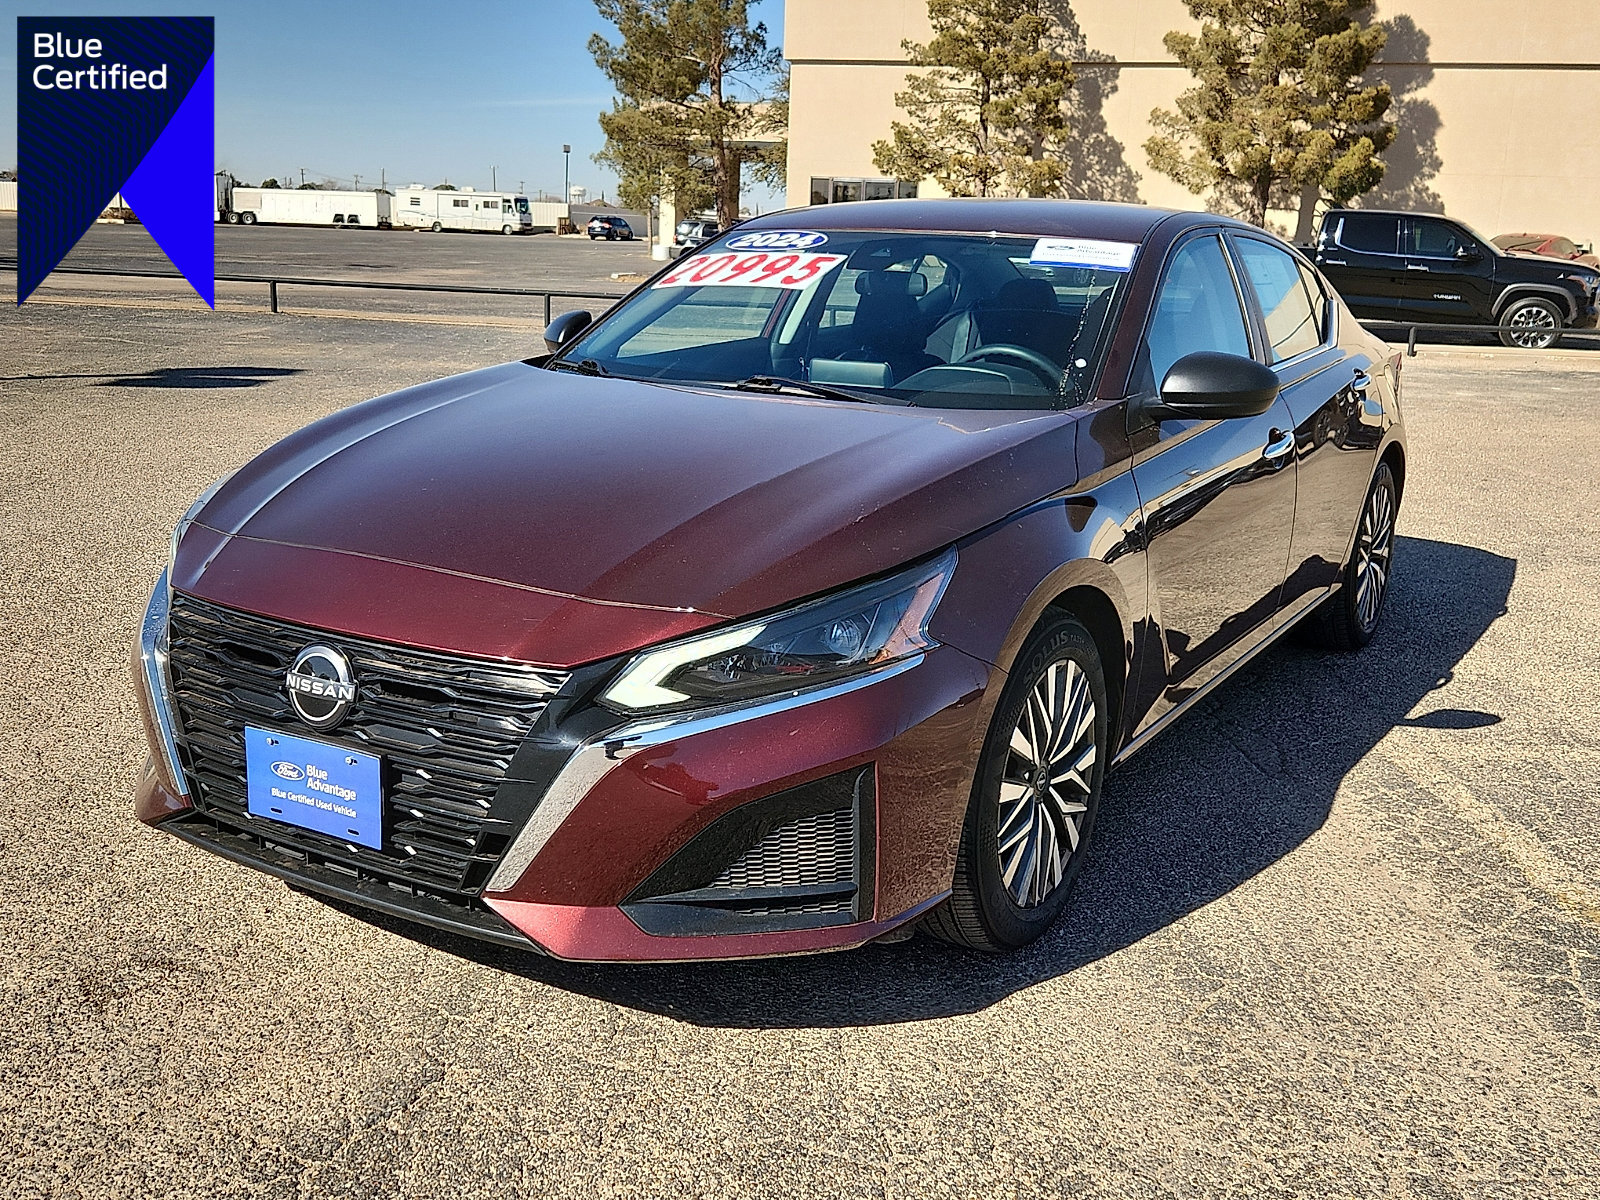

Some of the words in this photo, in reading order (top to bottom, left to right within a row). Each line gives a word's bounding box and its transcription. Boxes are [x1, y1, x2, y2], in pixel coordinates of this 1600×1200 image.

[738, 232, 815, 248] 2024
[659, 253, 838, 285] 20995
[1023, 630, 1068, 688] SOLUS
[286, 673, 353, 700] NISSAN
[276, 762, 300, 779] Ford
[306, 764, 328, 780] Blue
[306, 779, 357, 801] Advantage
[271, 787, 287, 799] Blue
[287, 791, 315, 807] Certified
[315, 799, 333, 811] Used
[333, 803, 357, 818] Vehicle
